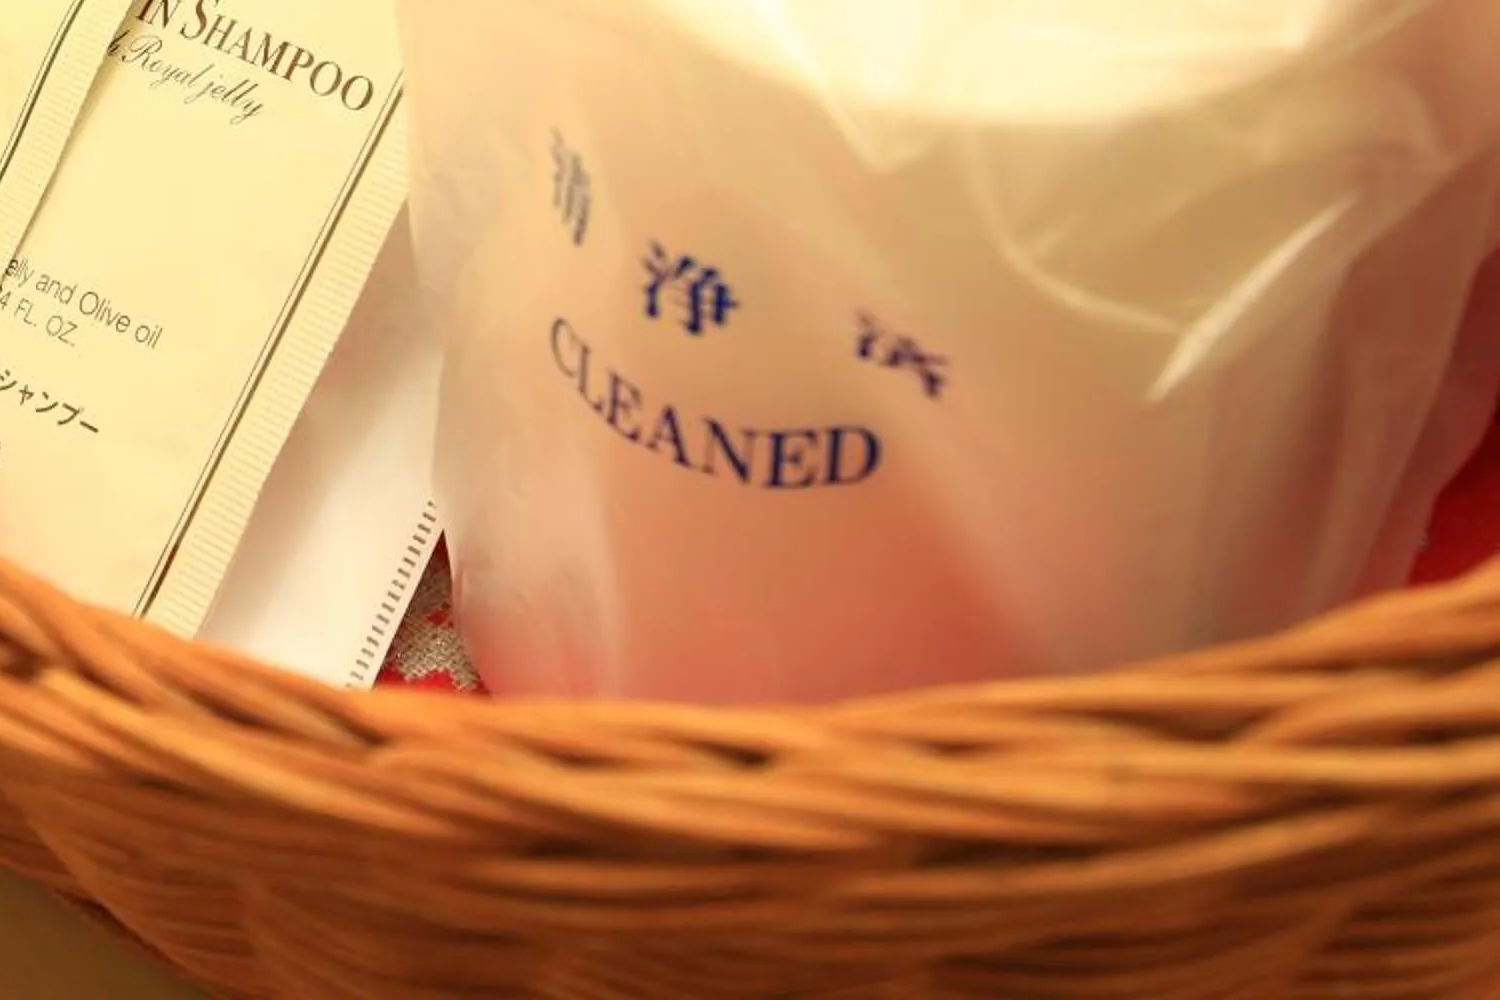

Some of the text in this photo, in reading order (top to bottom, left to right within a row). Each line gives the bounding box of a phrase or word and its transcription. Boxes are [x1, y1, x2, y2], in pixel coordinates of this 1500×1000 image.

[121, 33, 207, 88] Royal
[182, 73, 265, 125] jelly
[4, 258, 164, 349] elly and Olive oil
[13, 298, 37, 328] FL.
[45, 314, 78, 347] OZ.
[549, 316, 884, 491] CLEANED
